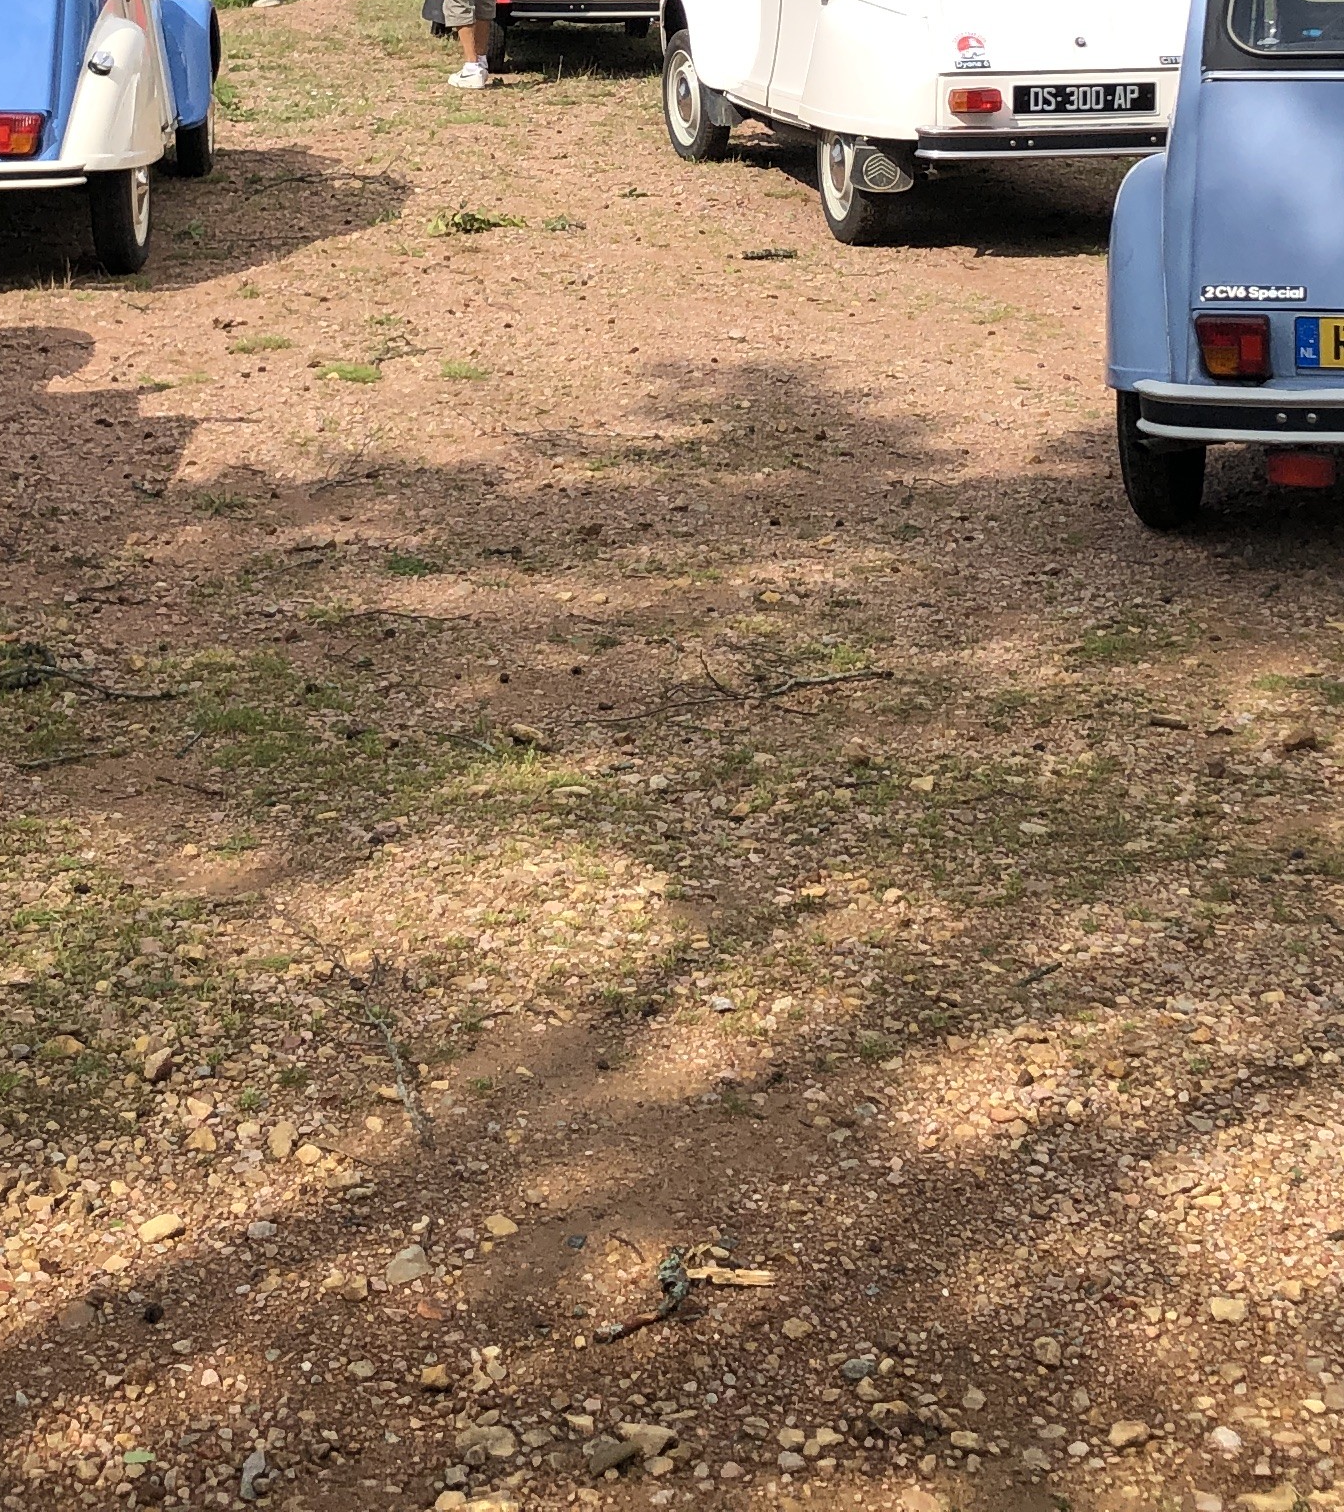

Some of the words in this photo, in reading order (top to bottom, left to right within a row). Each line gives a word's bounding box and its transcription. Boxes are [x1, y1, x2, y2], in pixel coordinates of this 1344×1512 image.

[1029, 85, 1140, 112] DS-300-AP
[1204, 286, 1247, 299] 2CV6
[1248, 285, 1304, 301] Spécial
[1299, 346, 1317, 359] NL
